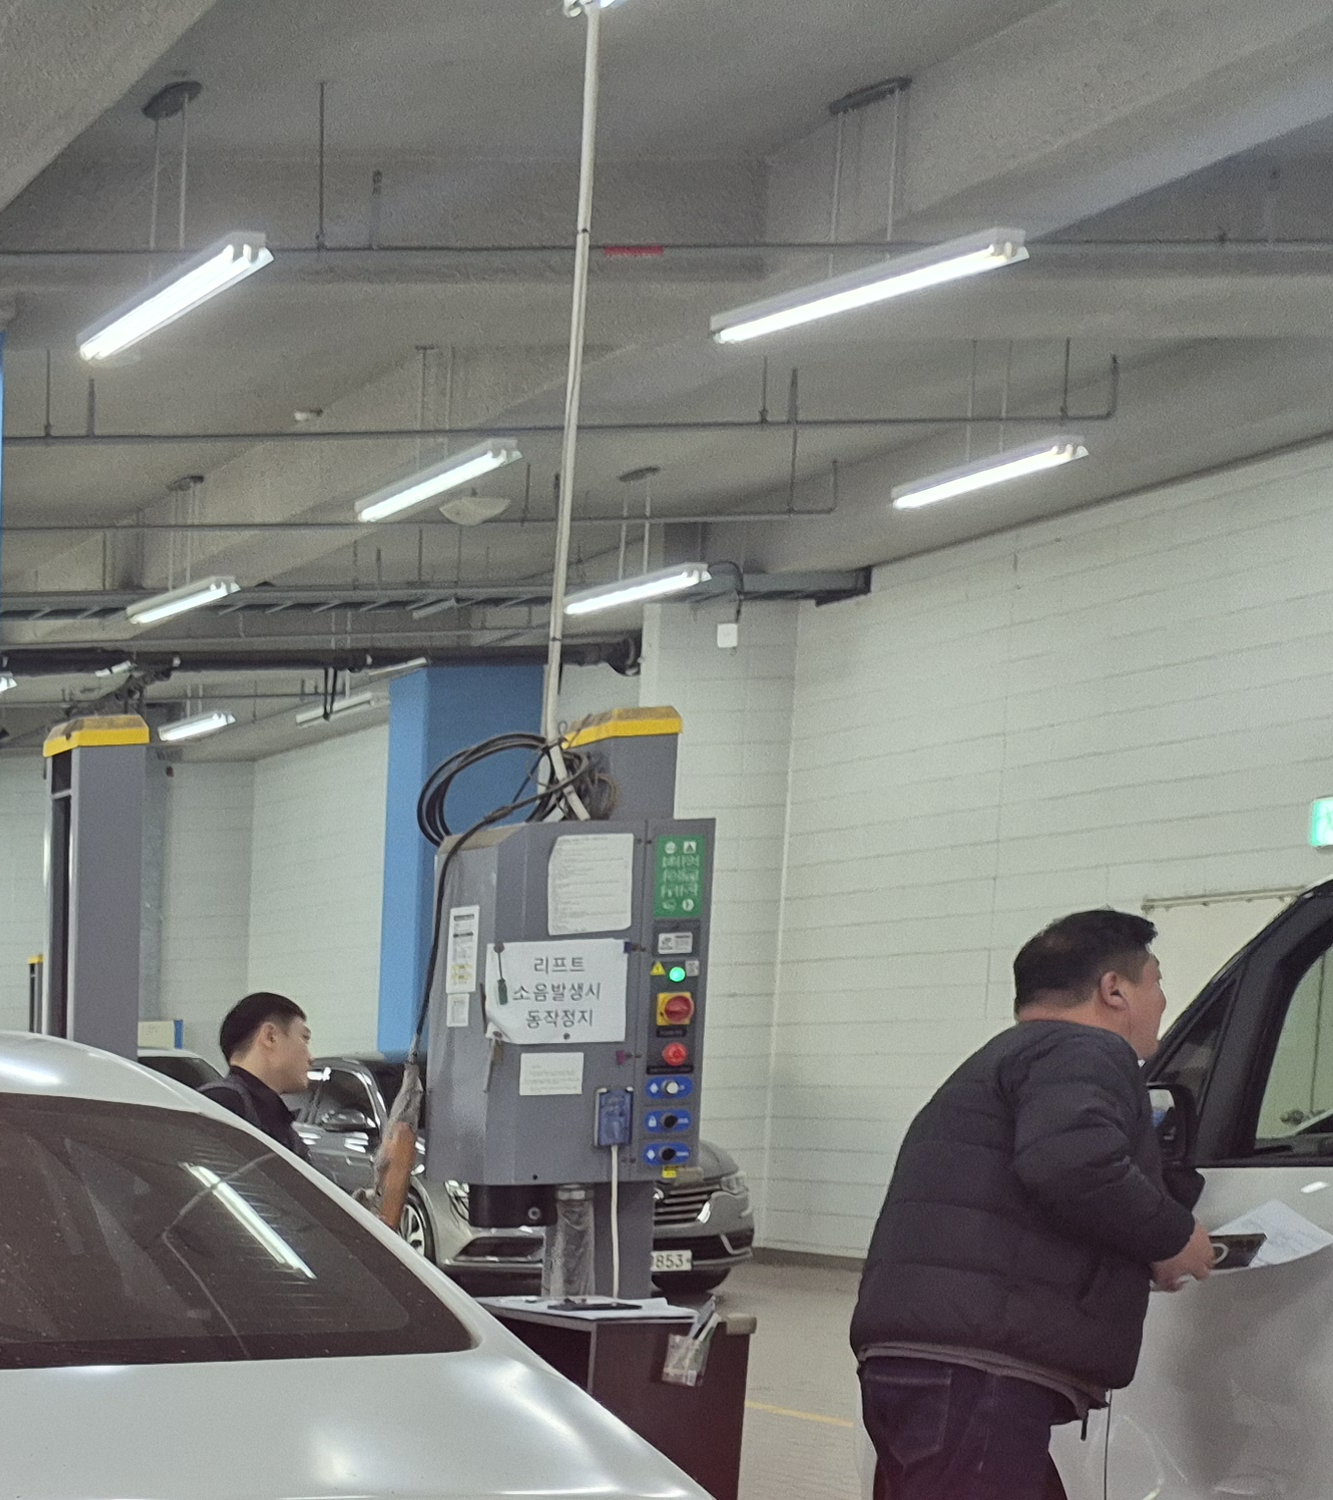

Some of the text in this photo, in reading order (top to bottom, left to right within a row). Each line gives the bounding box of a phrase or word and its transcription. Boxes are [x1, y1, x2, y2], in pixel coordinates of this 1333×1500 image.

[534, 956, 585, 975] 리프트
[513, 981, 601, 1002] 소음발생시
[526, 1008, 593, 1029] 동작정지
[652, 1254, 684, 1269] 853
